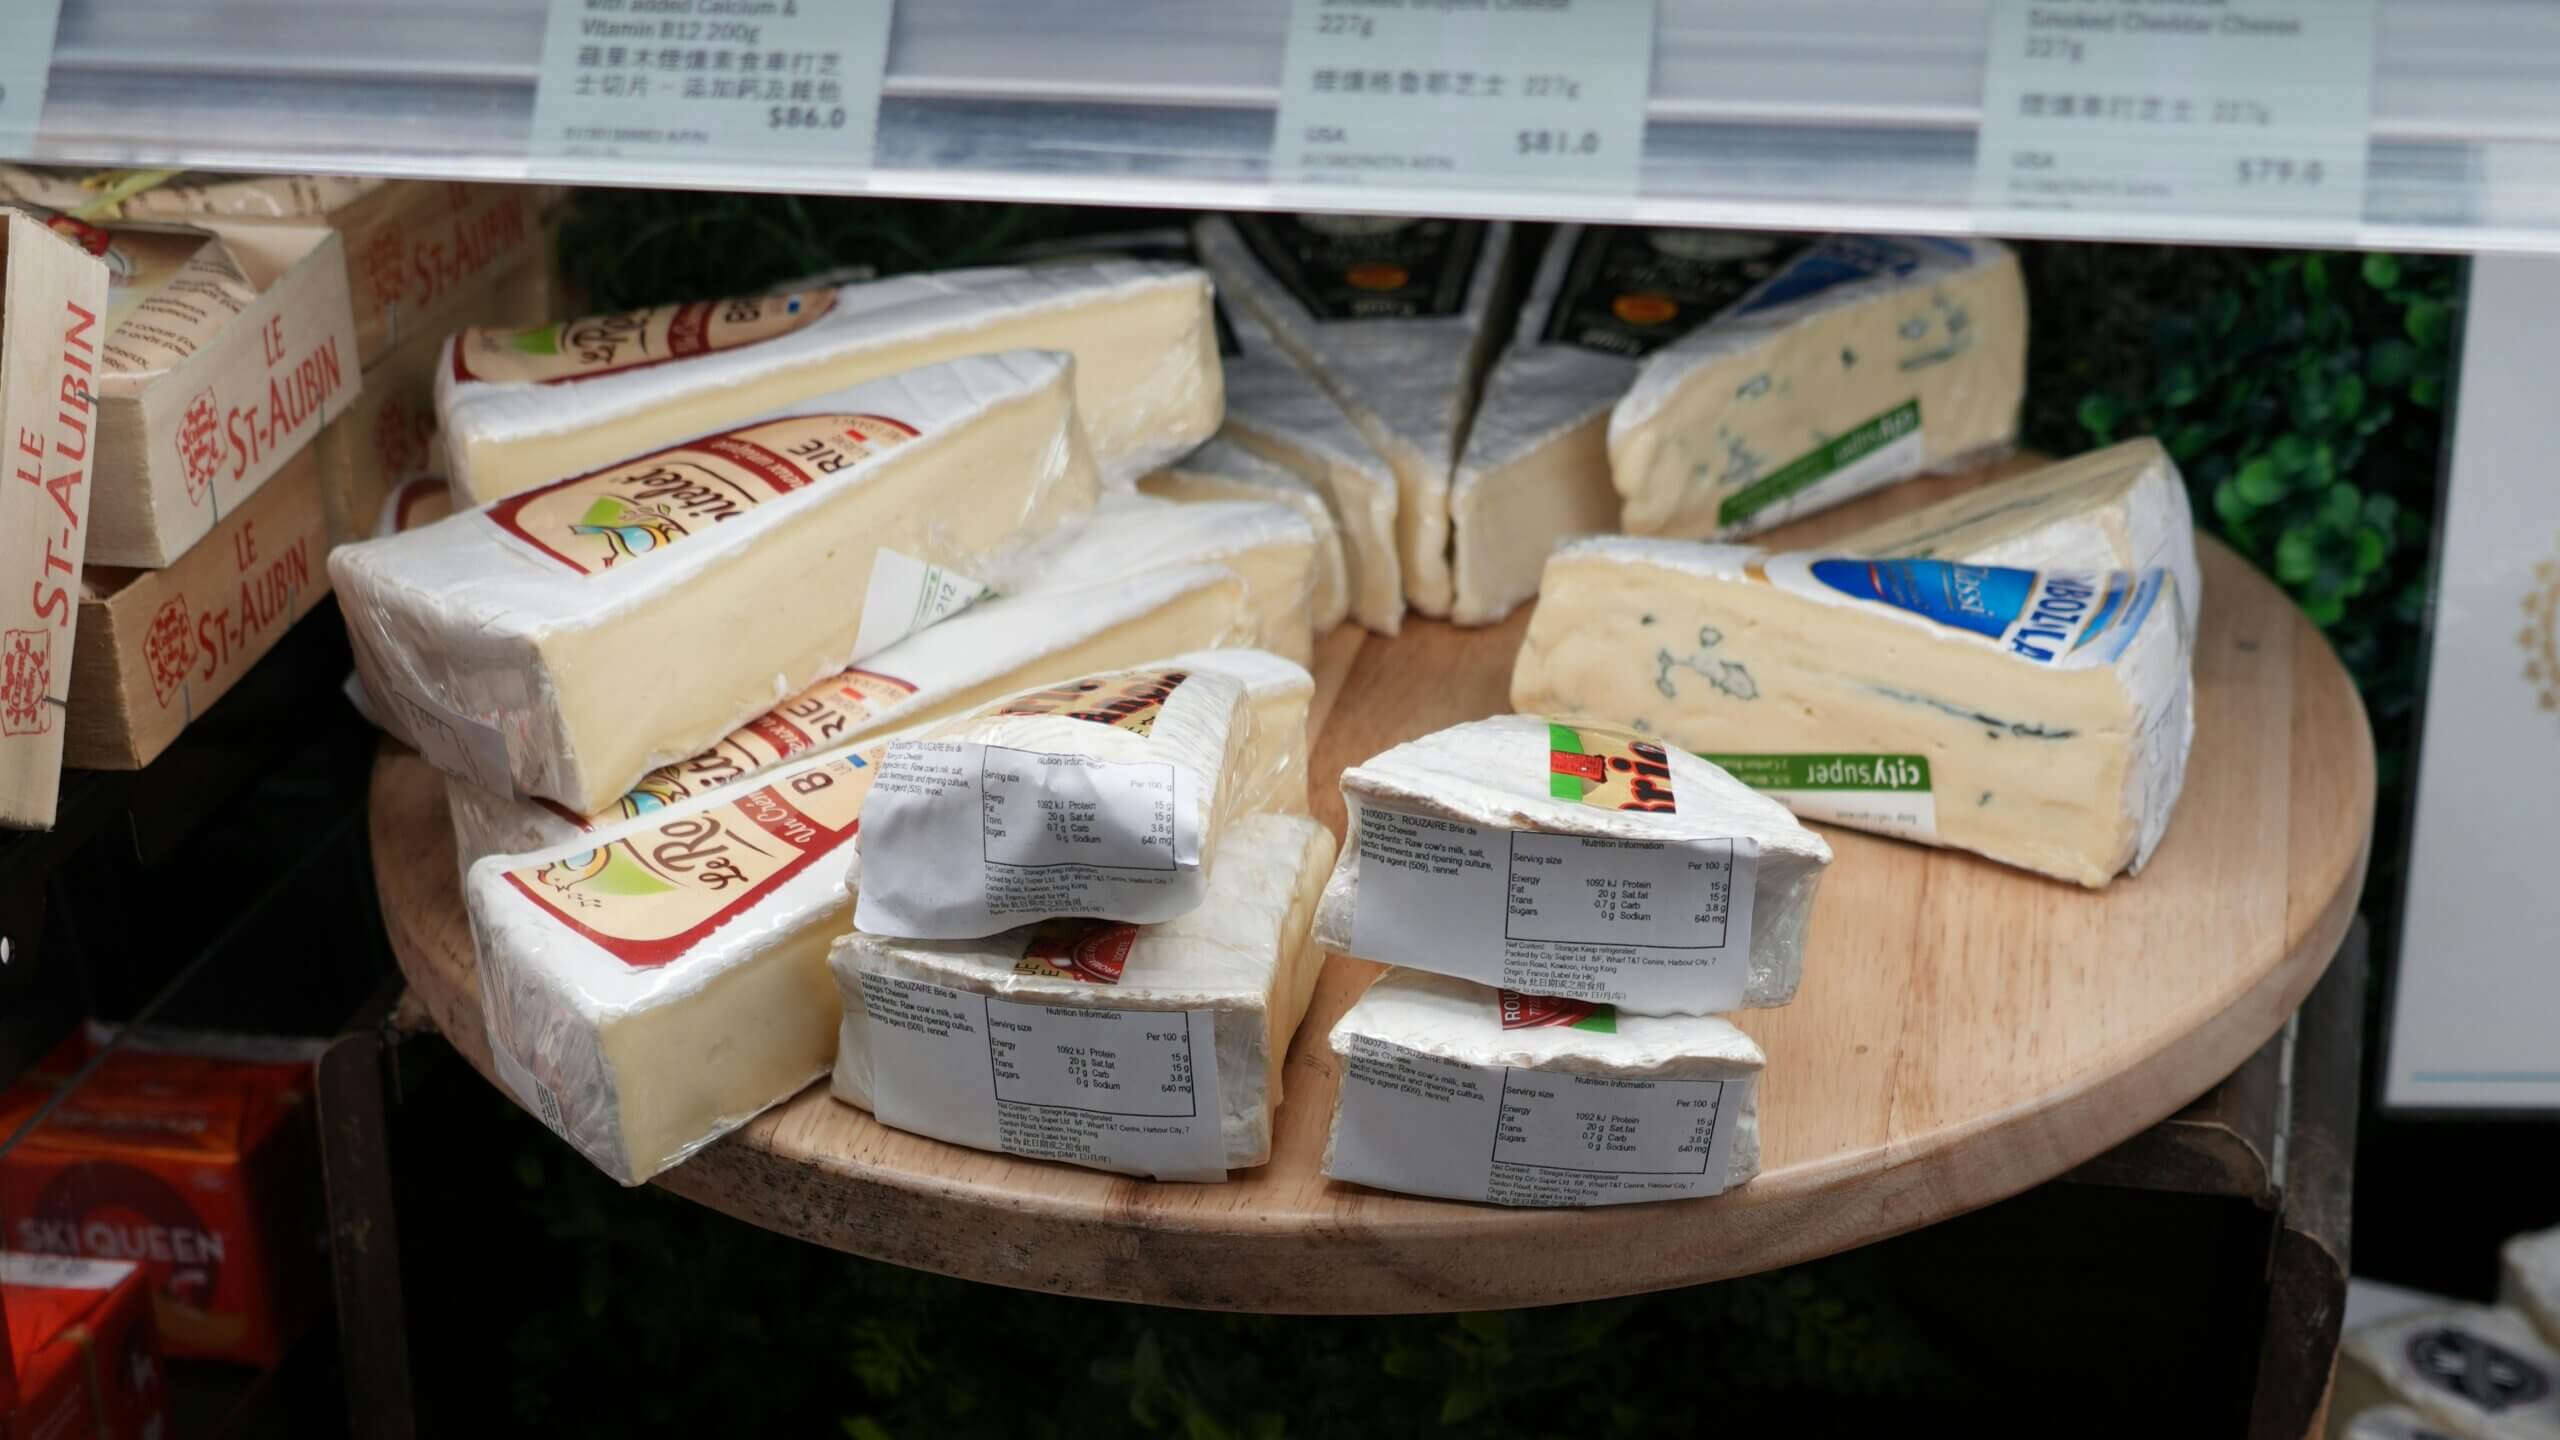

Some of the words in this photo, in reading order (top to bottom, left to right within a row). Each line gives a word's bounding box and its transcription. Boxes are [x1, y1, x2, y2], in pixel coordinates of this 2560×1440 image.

[700, 0, 776, 16] Calcium
[582, 19, 654, 38] Vitamin
[660, 21, 700, 40] B12
[706, 23, 762, 44] 200g
[1318, 14, 1375, 38] 227g
[2026, 37, 2085, 62] 227g
[1523, 75, 1579, 100] 227g
[769, 106, 846, 129] $86.0
[1517, 130, 1599, 154] $81.0
[2238, 158, 2323, 185] $79.0
[262, 314, 285, 369] LE
[227, 335, 341, 482] ST-AUBIN
[17, 426, 46, 487] LE
[33, 301, 96, 627] ST-AUBIN
[234, 520, 258, 572] LE
[199, 538, 309, 681] ST-AUBIN
[1069, 801, 1096, 810] Protein
[1155, 813, 1164, 821] 15
[1402, 816, 1446, 831] ROUZAIRE
[1449, 824, 1464, 834] Brie
[1467, 827, 1477, 835] de
[1152, 824, 1163, 832] 3.8
[1388, 824, 1416, 836] Cheese
[652, 811, 728, 876] Ro
[1142, 836, 1156, 845] 640
[1159, 838, 1171, 846] mg
[1405, 838, 1422, 848] Raw
[1425, 843, 1446, 852] cow's
[1448, 845, 1465, 856] milk,
[1469, 849, 1484, 858] salt,
[1582, 839, 1616, 848] Nutrition
[1618, 840, 1664, 850] Information
[1361, 849, 1384, 863] firming
[1387, 857, 1406, 868] agent
[1362, 839, 1379, 850] lactic
[1381, 843, 1412, 858] ferments
[1415, 851, 1429, 860] and
[1432, 854, 1462, 866] ripening
[1465, 859, 1493, 871] culture,
[1513, 853, 1543, 865] Serving
[1546, 856, 1562, 864] size
[698, 856, 749, 890] Le
[1688, 862, 1701, 870] Per
[1705, 862, 1719, 870] 100
[1512, 874, 1540, 885] Energy
[1586, 879, 1604, 888] 1092
[1607, 879, 1617, 888] kJ
[1622, 881, 1651, 889] Protein
[1710, 882, 1719, 891] 15
[1512, 885, 1524, 894] Fat
[1598, 889, 1608, 898] 20
[1622, 891, 1648, 899] Sat.fat
[1710, 893, 1718, 901] 15
[1510, 895, 1532, 905] Trans
[1594, 900, 1606, 908] 0.7
[1621, 902, 1640, 910] Carb
[1706, 904, 1718, 912] 3.8
[1509, 906, 1538, 916] Sugars
[1620, 912, 1651, 921] Sodium
[1695, 915, 1709, 923] 640
[1712, 916, 1724, 925] mg
[894, 980, 932, 992] ROUZAIRE
[901, 1002, 914, 1010] Raw
[917, 1006, 935, 1014] cow's
[1046, 1007, 1077, 1018] Nutrition
[1079, 1009, 1121, 1020] Information
[911, 1012, 922, 1022] and
[925, 1016, 950, 1029] ripening
[990, 1018, 1015, 1031] Serving
[1018, 1024, 1032, 1032] size
[1147, 1032, 1159, 1041] Per
[1163, 1033, 1176, 1041] 100
[992, 1037, 1015, 1049] Energy
[1057, 1045, 1073, 1055] 1092
[1076, 1047, 1084, 1055] kJ
[1090, 1048, 1115, 1059] Protein
[1171, 1053, 1180, 1061] 15
[994, 1058, 1013, 1068] Trans
[1068, 1066, 1080, 1075] 0.7
[1092, 1068, 1109, 1078] Carb
[1170, 1074, 1182, 1082] 3.8
[1070, 1057, 1079, 1066] 20
[1091, 1058, 1115, 1069] Sat.fat
[995, 1068, 1019, 1080] Sugars
[1092, 1079, 1120, 1090] Sodium
[1162, 1084, 1176, 1093] 640
[1178, 1085, 1191, 1094] mg
[1575, 1076, 1608, 1087] Nutrition
[1611, 1080, 1655, 1089] Information
[1506, 1086, 1536, 1098] Serving
[1538, 1090, 1554, 1098] size
[1677, 1100, 1691, 1108] Per
[1694, 1100, 1707, 1108] 100
[1502, 1114, 1514, 1123] Fat
[1586, 1122, 1597, 1131] 20
[1609, 1125, 1635, 1133] Sat.fat
[1695, 1127, 1704, 1135] 15
[1503, 1105, 1531, 1115] Energy
[1575, 1112, 1594, 1121] 1092
[1596, 1114, 1606, 1122] kJ
[1612, 1116, 1639, 1124] Protein
[1696, 1118, 1706, 1126] 15
[1501, 1124, 1522, 1133] Trans
[1582, 1132, 1595, 1140] 0.7
[1608, 1134, 1626, 1142] Carb
[1499, 1133, 1526, 1143] Sugars
[1606, 1143, 1636, 1152] Sodium
[1678, 1145, 1692, 1153] 640
[1695, 1146, 1707, 1154] mg
[16, 1217, 79, 1257] SKI
[84, 1222, 224, 1263] QUEEN
